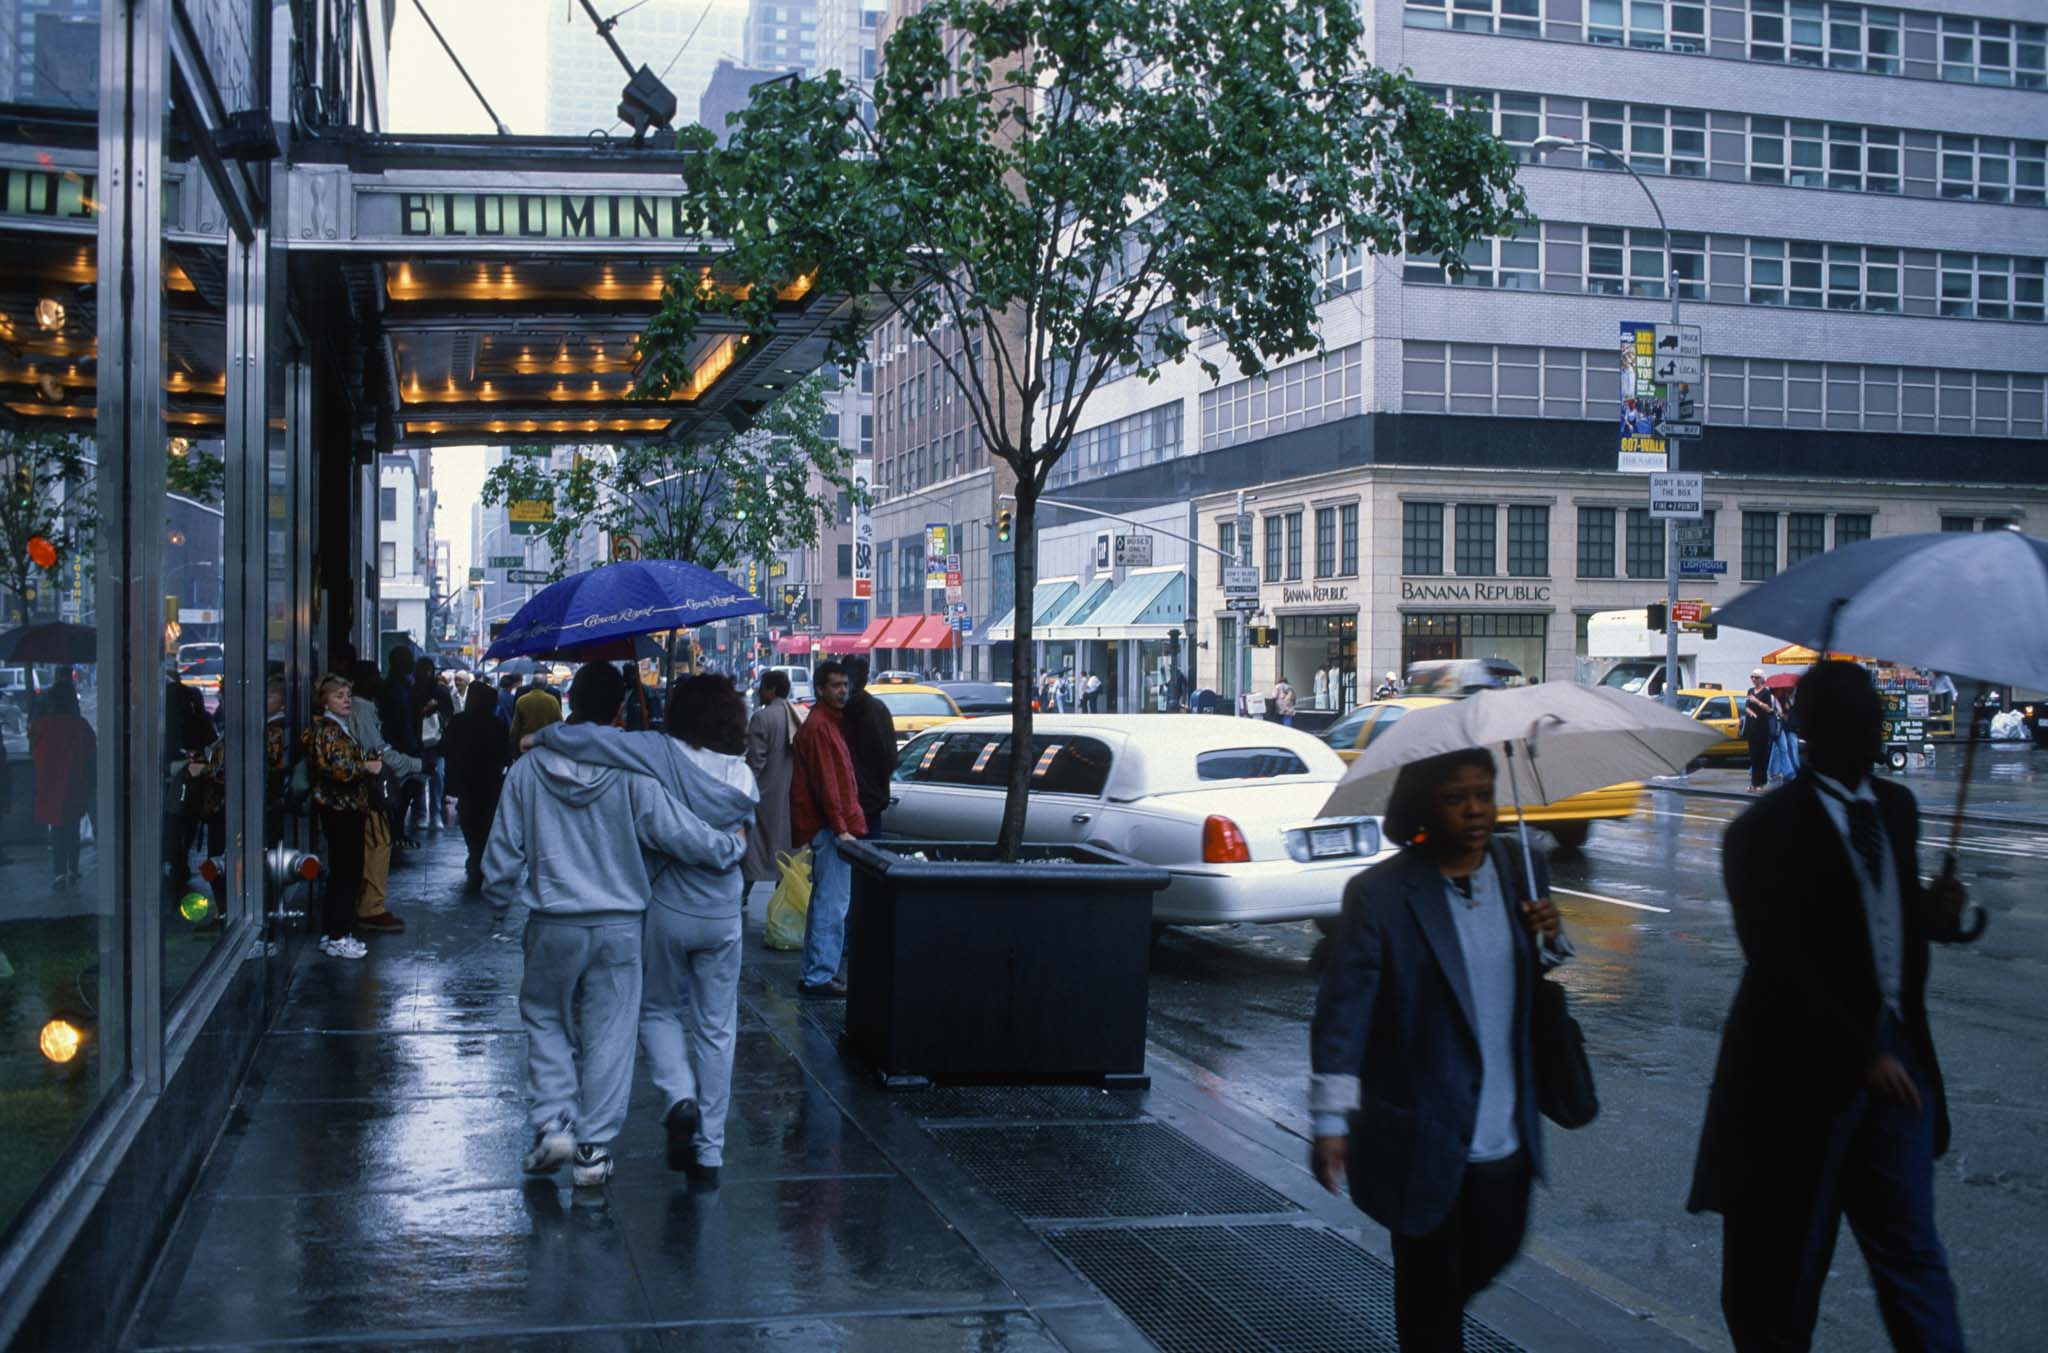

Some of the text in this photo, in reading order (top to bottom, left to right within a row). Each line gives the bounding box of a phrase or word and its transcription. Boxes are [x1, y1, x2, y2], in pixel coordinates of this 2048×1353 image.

[1681, 334, 1698, 342] TRUCK
[1680, 347, 1698, 355] ROUTE
[1680, 364, 1697, 374] LOCAL
[1661, 425, 1698, 433] ONE WAY
[1677, 479, 1699, 487] BLOCK
[1662, 488, 1691, 496] THE BOX
[1283, 585, 1348, 603] BANANA REPUBLIC
[1402, 582, 1550, 601] BANANA REPUBLIC
[686, 598, 711, 610] Crown
[584, 605, 655, 628] Crown Royal
